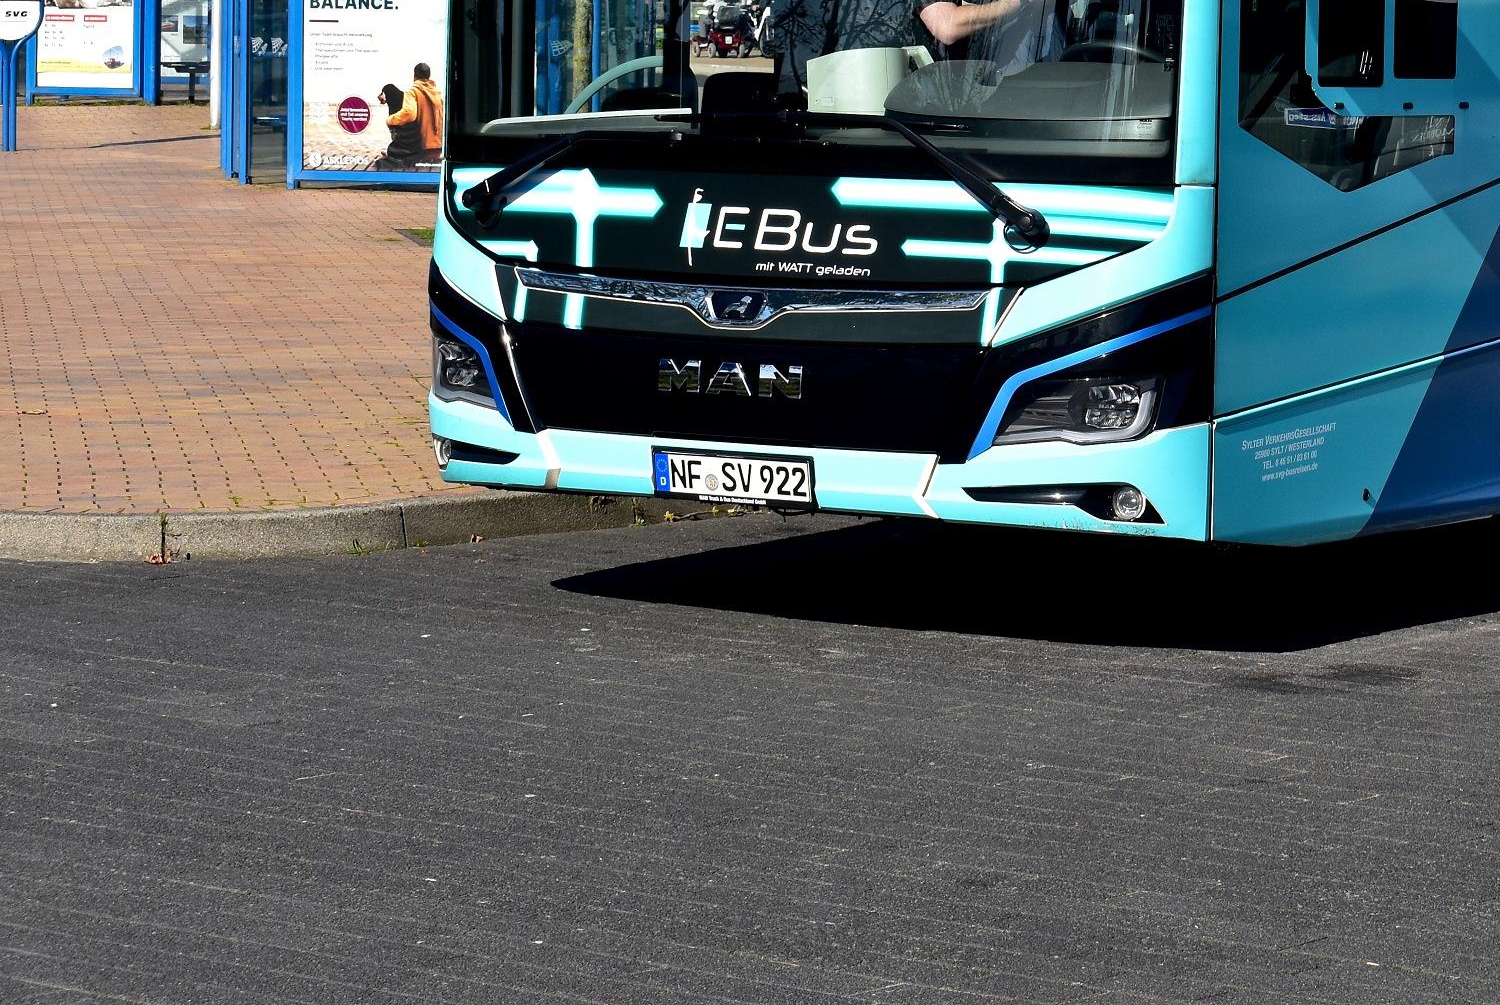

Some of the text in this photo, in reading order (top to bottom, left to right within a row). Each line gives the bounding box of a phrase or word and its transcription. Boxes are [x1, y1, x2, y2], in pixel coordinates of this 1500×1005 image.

[756, 262, 871, 277] mit WATT geladen
[659, 358, 803, 399] MAN
[1270, 445, 1284, 456] SYLT
[1288, 436, 1325, 452] WESTERLAND
[660, 477, 667, 486] D
[670, 458, 807, 497] NF SV 922
